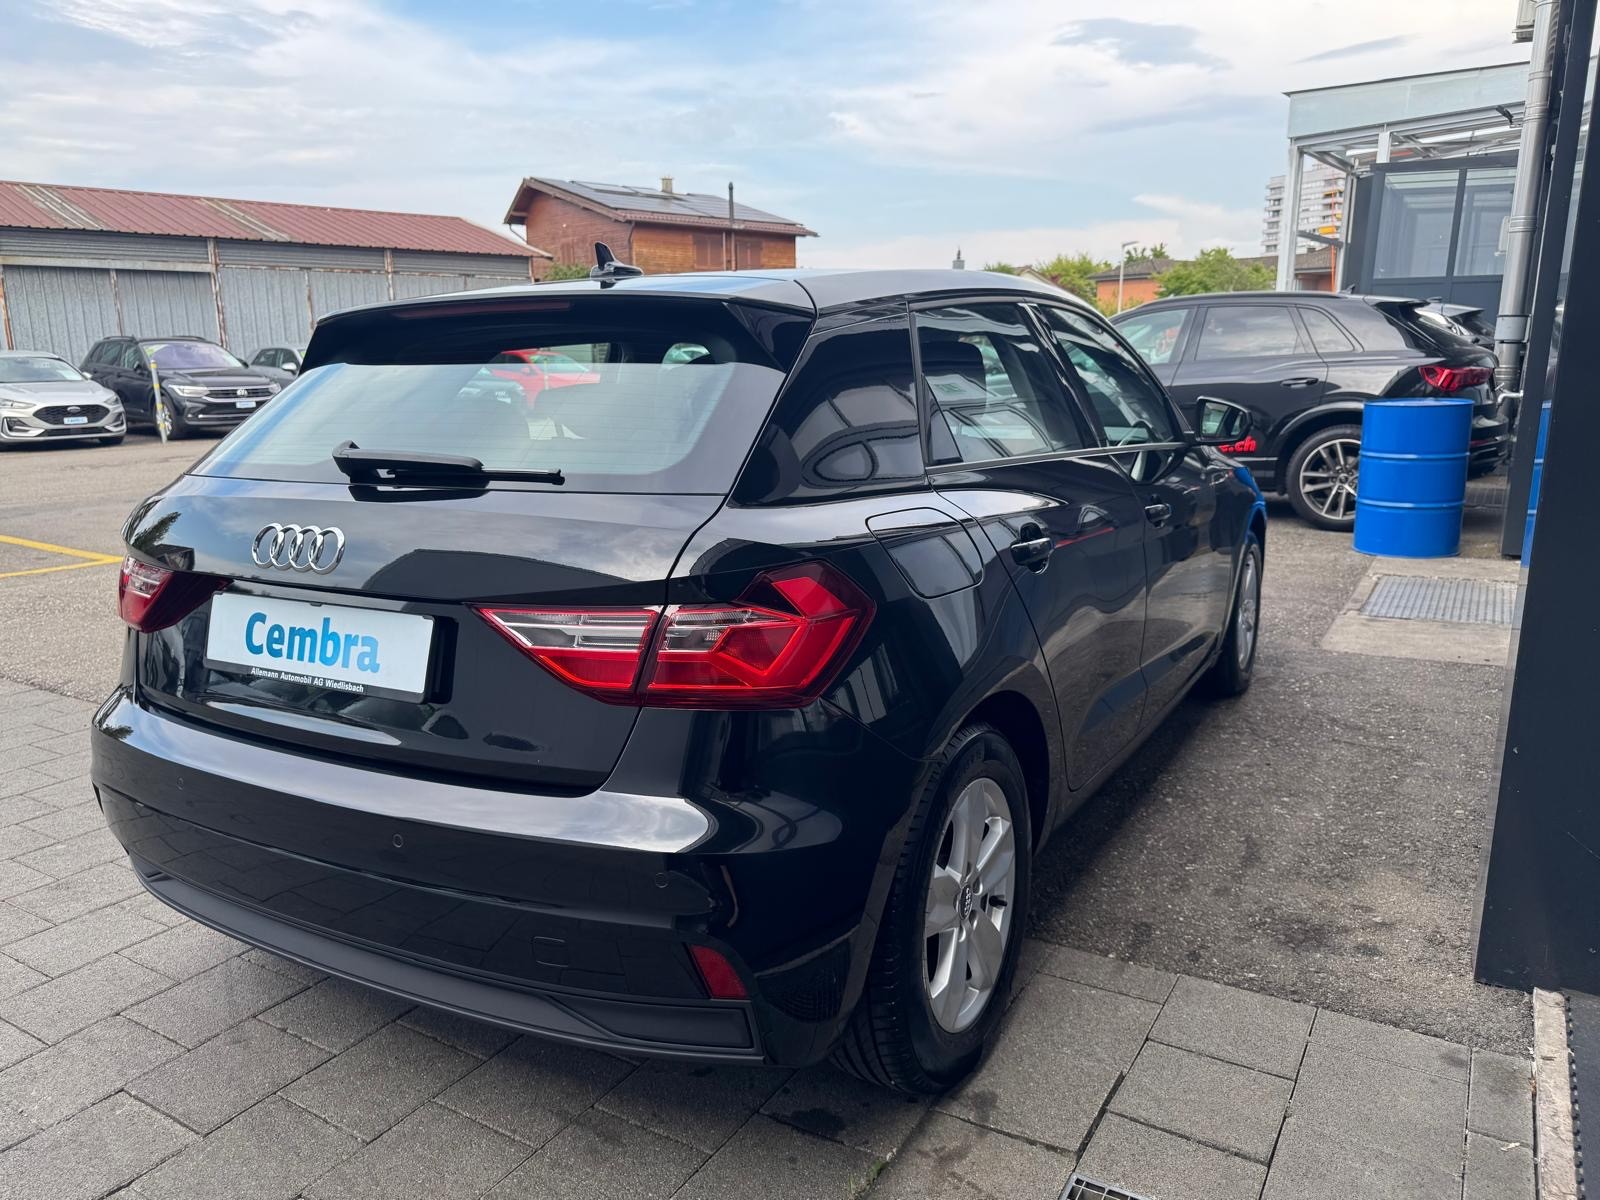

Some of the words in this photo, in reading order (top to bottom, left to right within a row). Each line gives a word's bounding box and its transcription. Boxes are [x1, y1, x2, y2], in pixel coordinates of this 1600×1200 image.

[245, 612, 380, 673] Cembra
[251, 667, 279, 679] Allemann
[280, 672, 312, 684] Automobil
[313, 679, 324, 687] AG
[325, 680, 364, 693] Wiedlisbach
